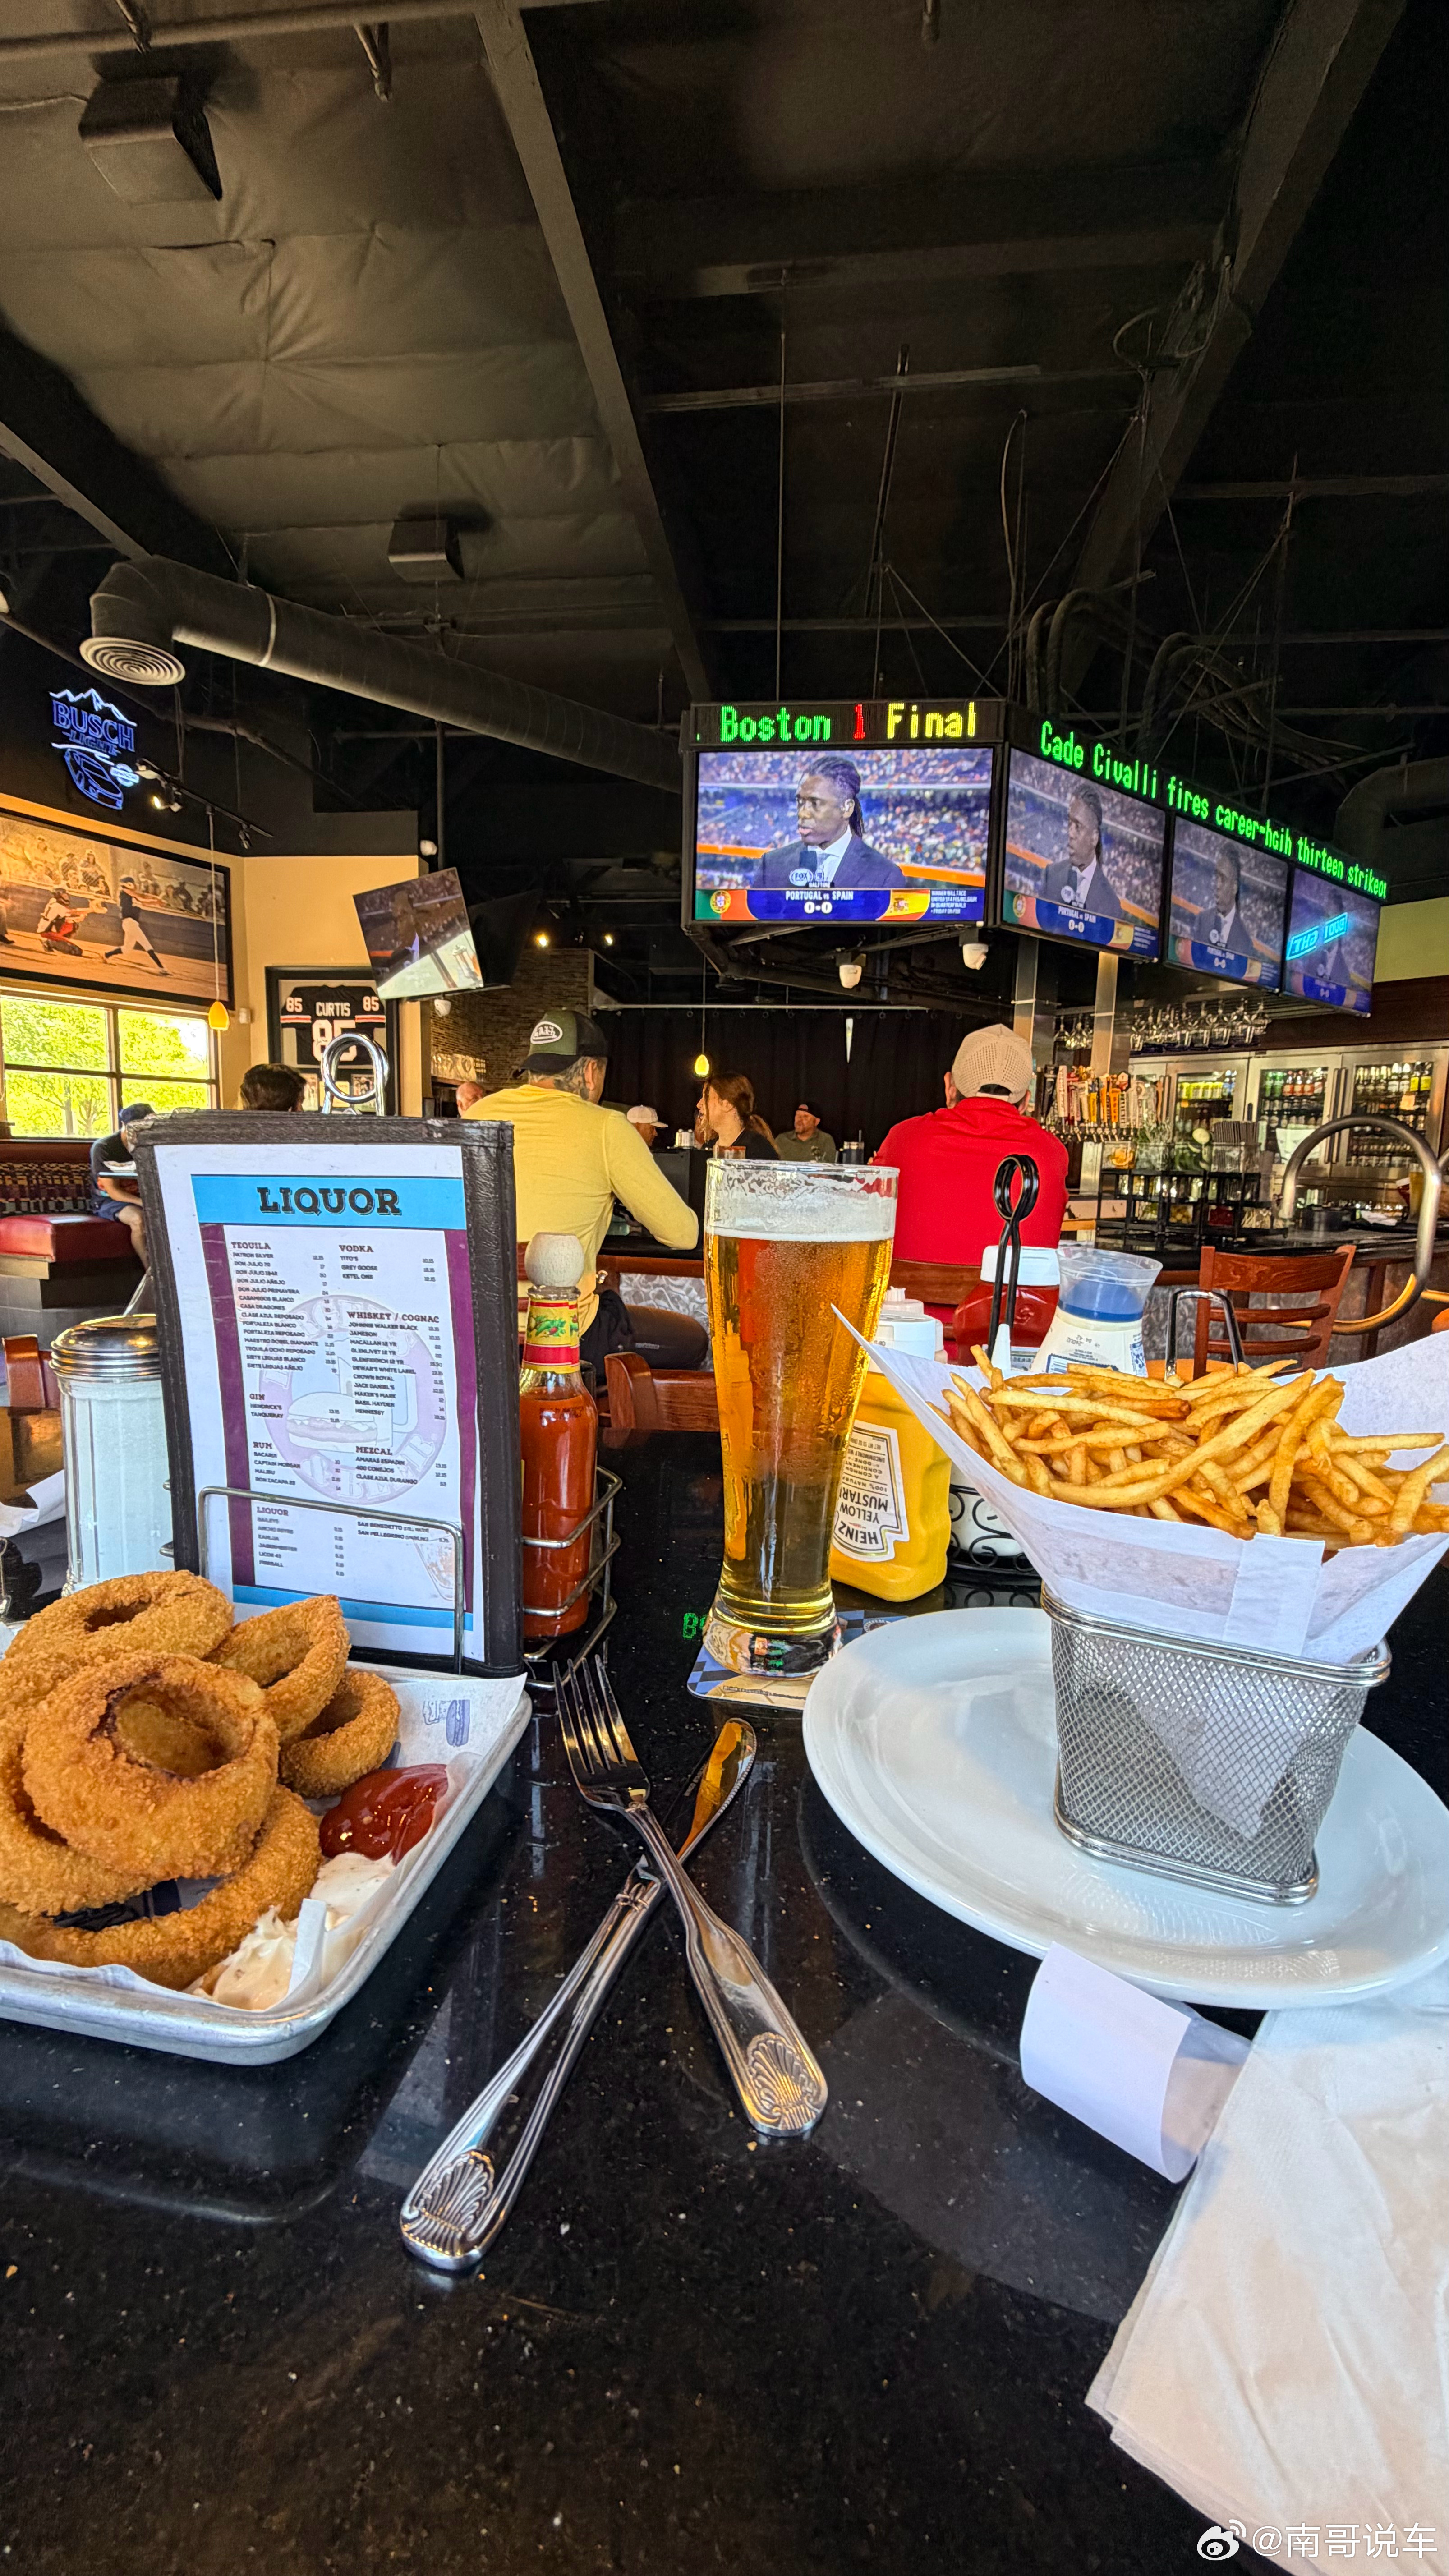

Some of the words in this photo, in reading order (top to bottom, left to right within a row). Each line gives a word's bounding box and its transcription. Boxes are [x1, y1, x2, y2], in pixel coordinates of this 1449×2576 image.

[52, 700, 135, 753] BUSCH
[720, 705, 831, 742] Boston
[853, 704, 866, 740] 1
[887, 701, 976, 739] Final
[1041, 721, 1084, 768] Cade
[1093, 743, 1157, 798] Civalli
[1168, 776, 1209, 819] fires
[1297, 837, 1344, 880] thirteen
[785, 891, 823, 901] PORTUGAL
[832, 891, 854, 901] SPAIN
[804, 901, 833, 914] 0-0
[286, 997, 303, 1012] 85
[316, 1002, 351, 1017] CURTIS
[363, 996, 379, 1011] 85
[312, 1020, 357, 1062] 85
[257, 1187, 402, 1216] LIQUOR
[231, 1242, 271, 1250] TEQUILA
[346, 1311, 391, 1320] WHISKEY
[401, 1314, 439, 1323] COGNAC
[356, 1446, 392, 1455] MEZCAL
[846, 1467, 872, 1477] COMMON
[869, 1483, 887, 1492] 100%
[839, 1486, 888, 1512] MUSTAR
[257, 1506, 289, 1516] LIQUOR
[840, 1502, 880, 1524] YELLOW
[838, 1521, 879, 1544] HEINZ
